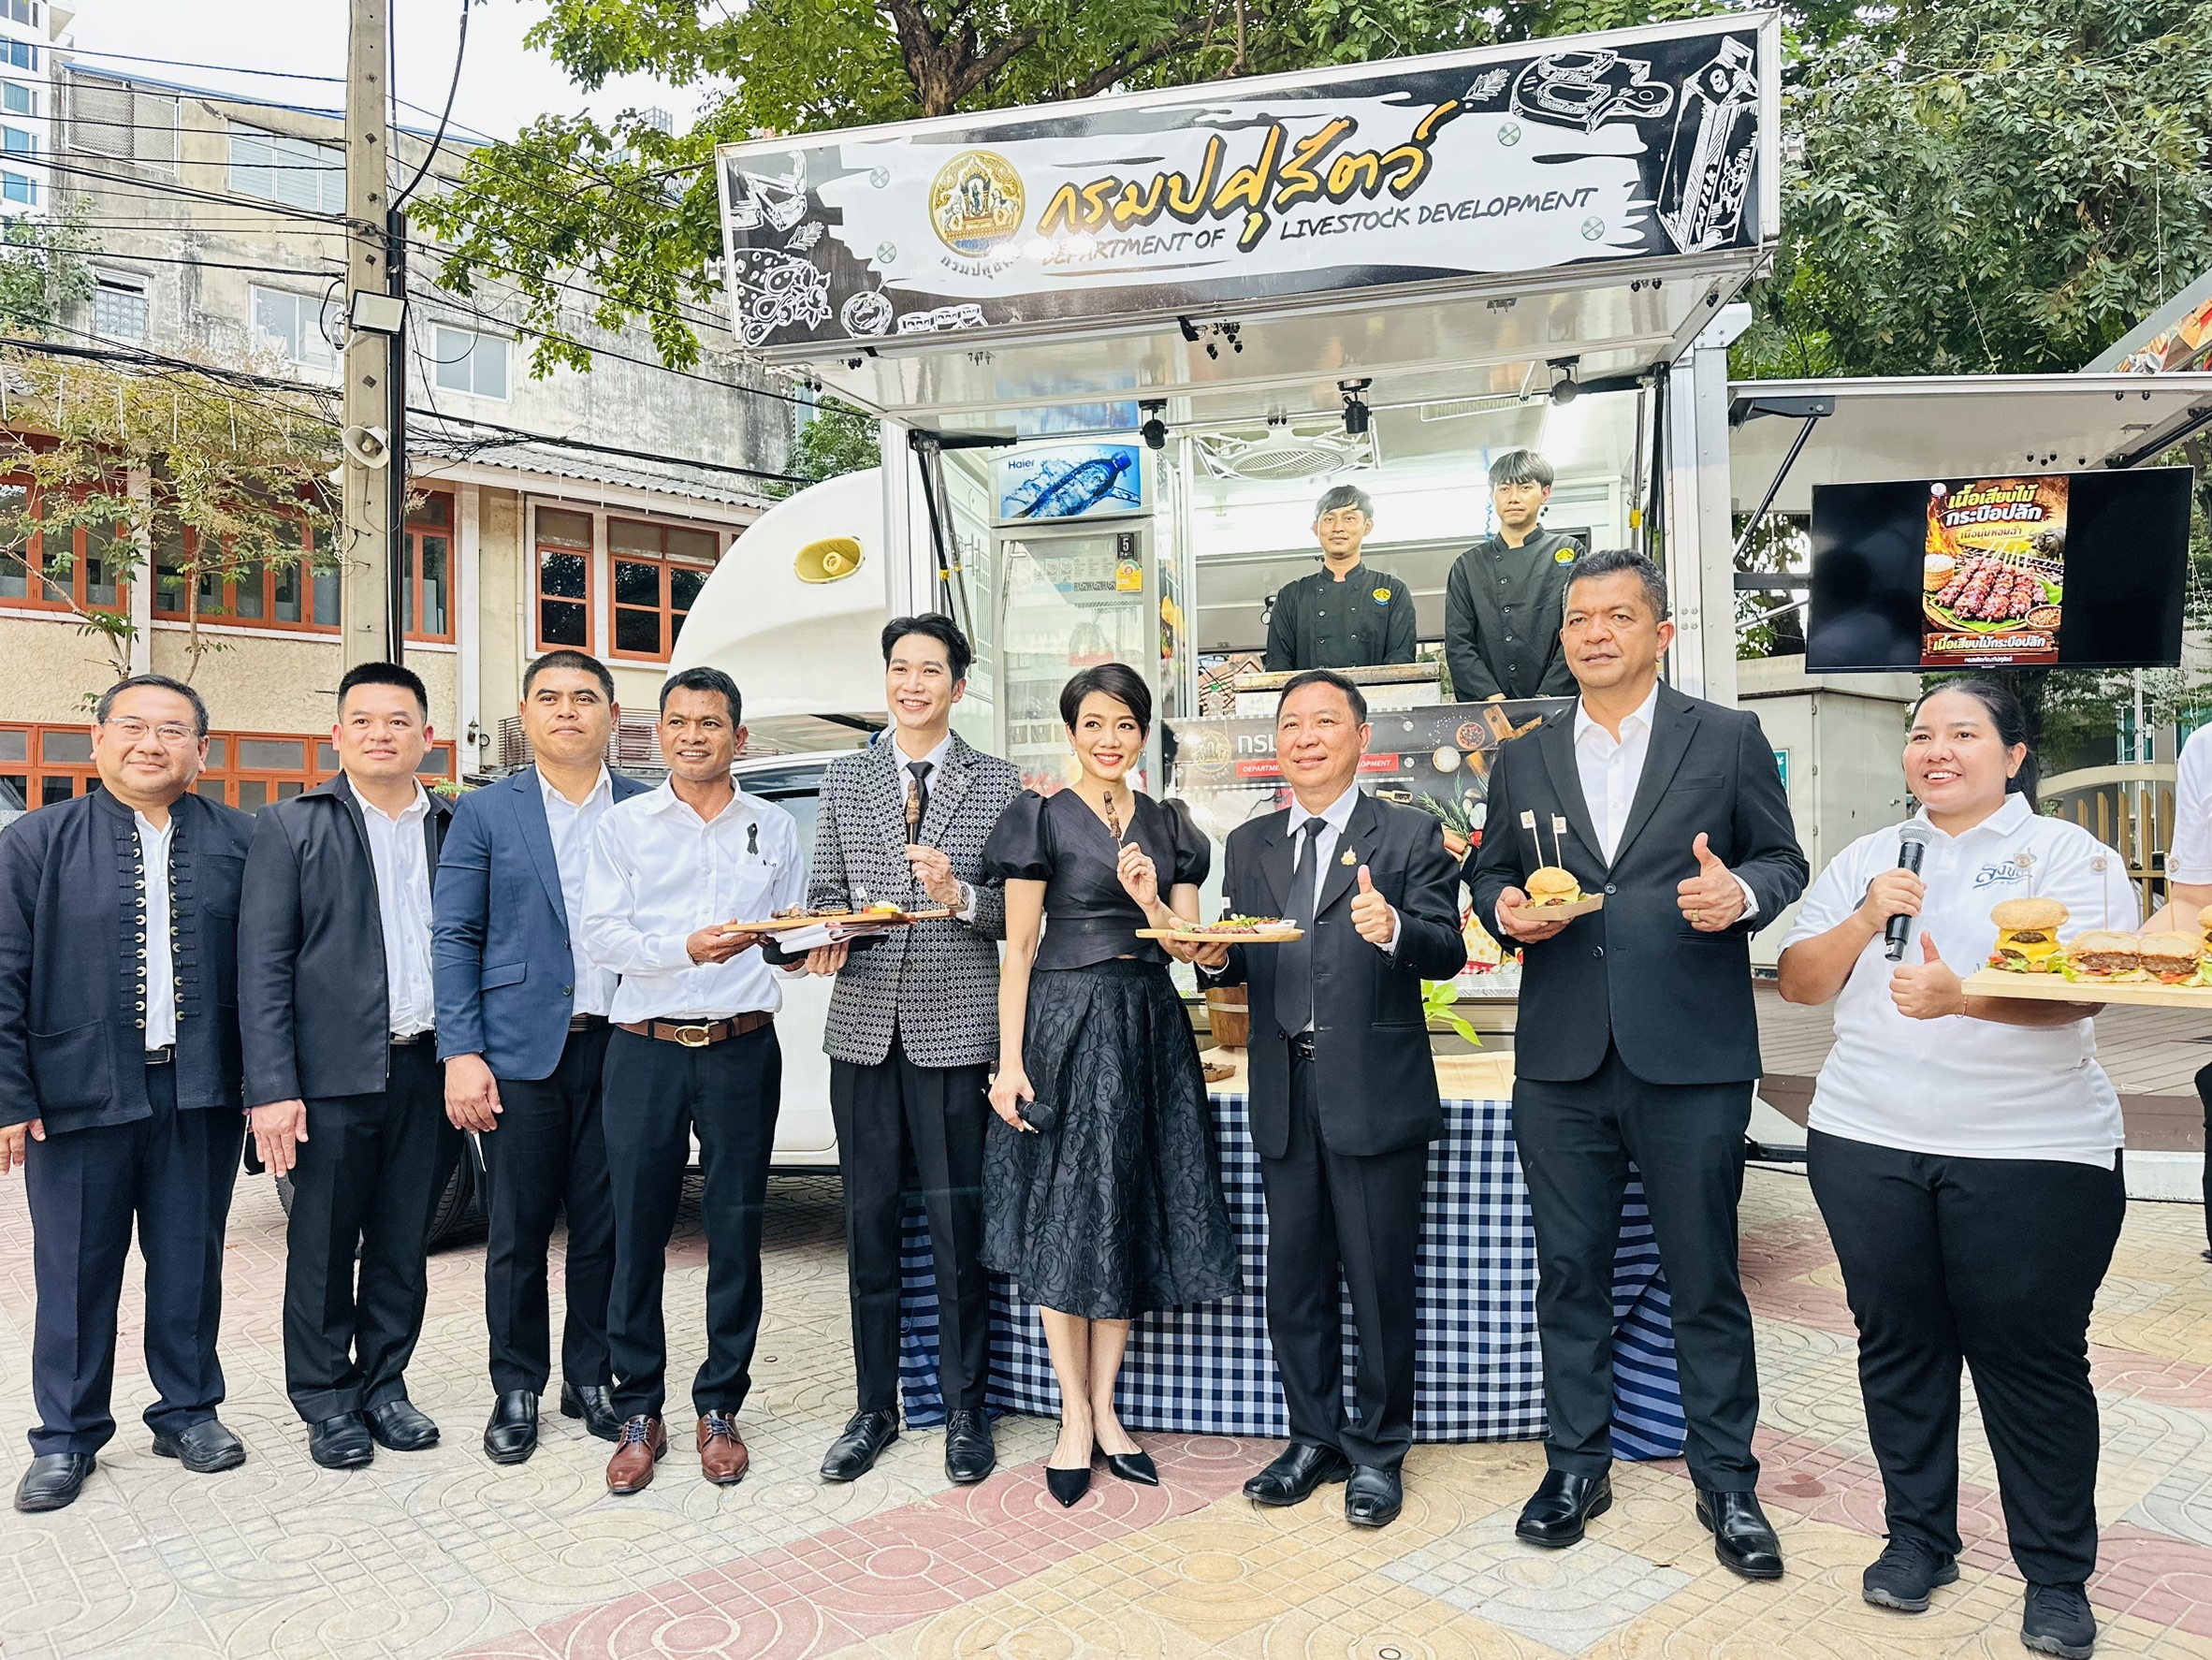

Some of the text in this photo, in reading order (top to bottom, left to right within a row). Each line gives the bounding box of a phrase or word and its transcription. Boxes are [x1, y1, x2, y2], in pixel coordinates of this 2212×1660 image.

[1037, 99, 1460, 253] กรมปศุสัตว์
[1194, 227, 1227, 250] OF
[1279, 206, 1411, 241] LIVESTOCK
[1417, 187, 1599, 225] DEVELOPMENT
[1008, 459, 1035, 470] Haier
[1947, 483, 2038, 509] เนื้อเสียบไม้
[1122, 537, 1129, 552] 5
[1243, 759, 1391, 773] DEPARTME LOPMENT
